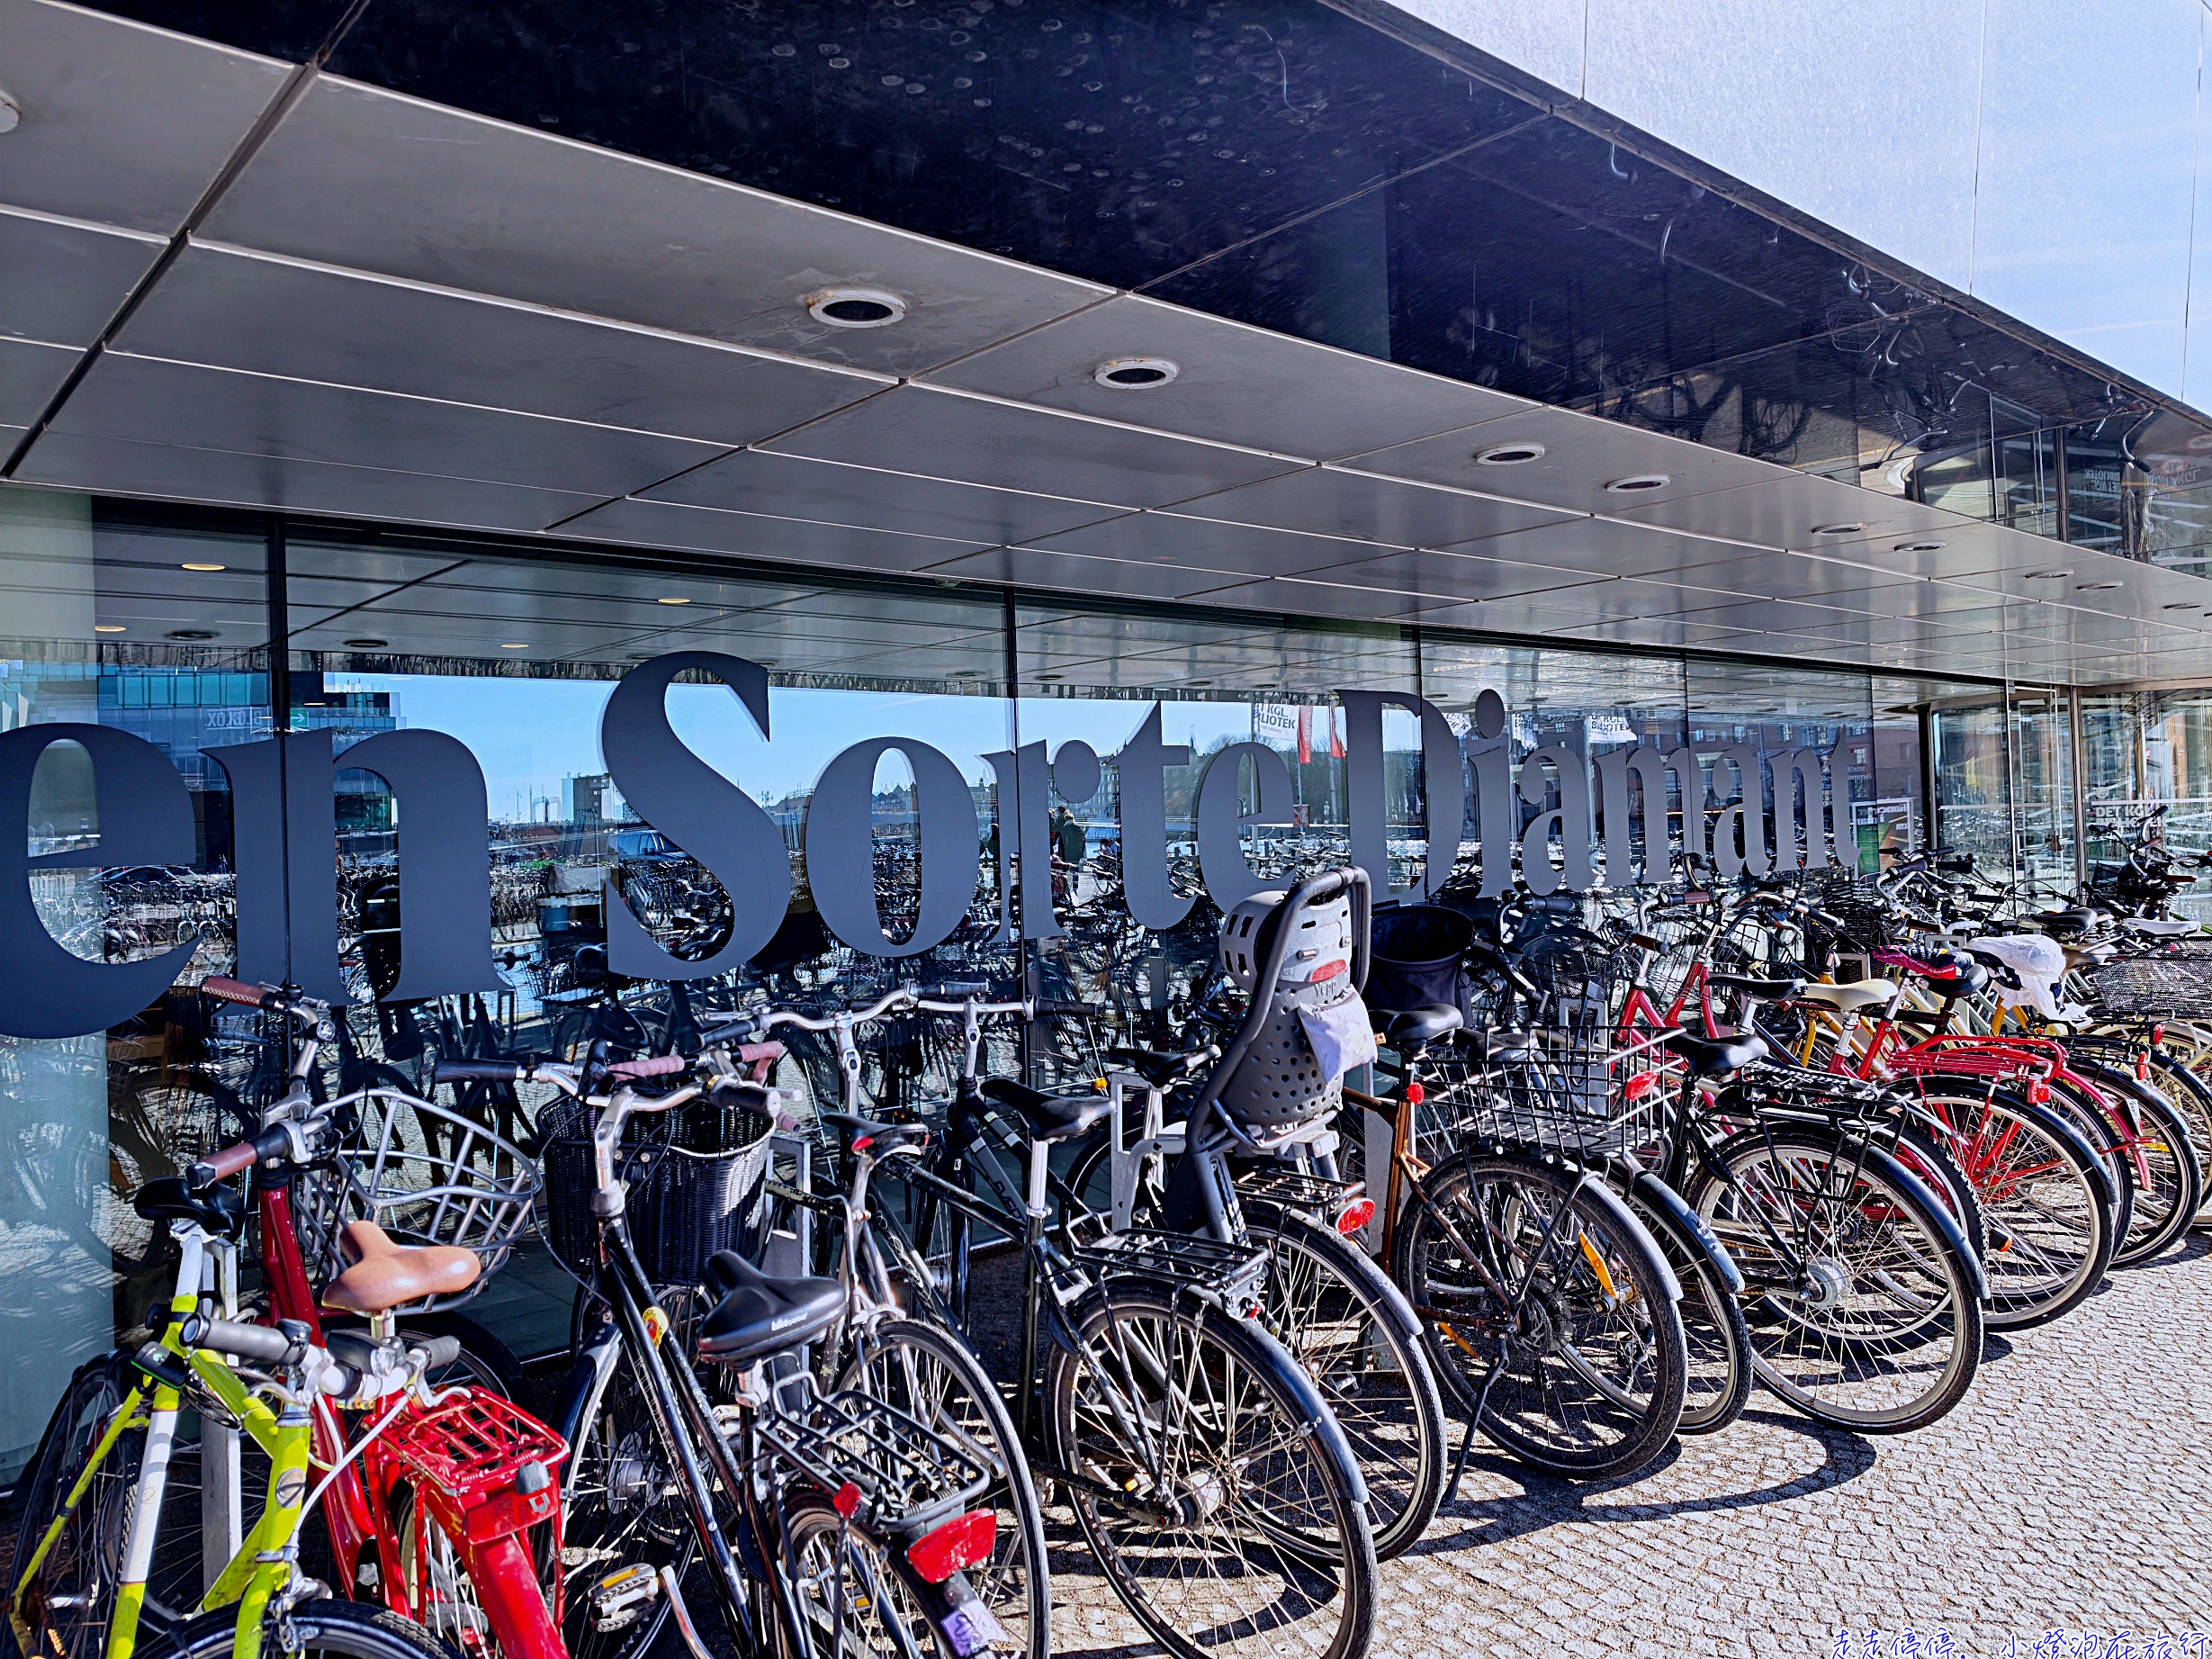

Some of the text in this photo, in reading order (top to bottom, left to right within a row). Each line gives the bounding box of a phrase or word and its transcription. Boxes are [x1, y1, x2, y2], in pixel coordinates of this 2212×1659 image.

[600, 650, 1294, 980] Sorte
[1334, 688, 1863, 902] Diamant
[2095, 806, 2122, 817] DET
